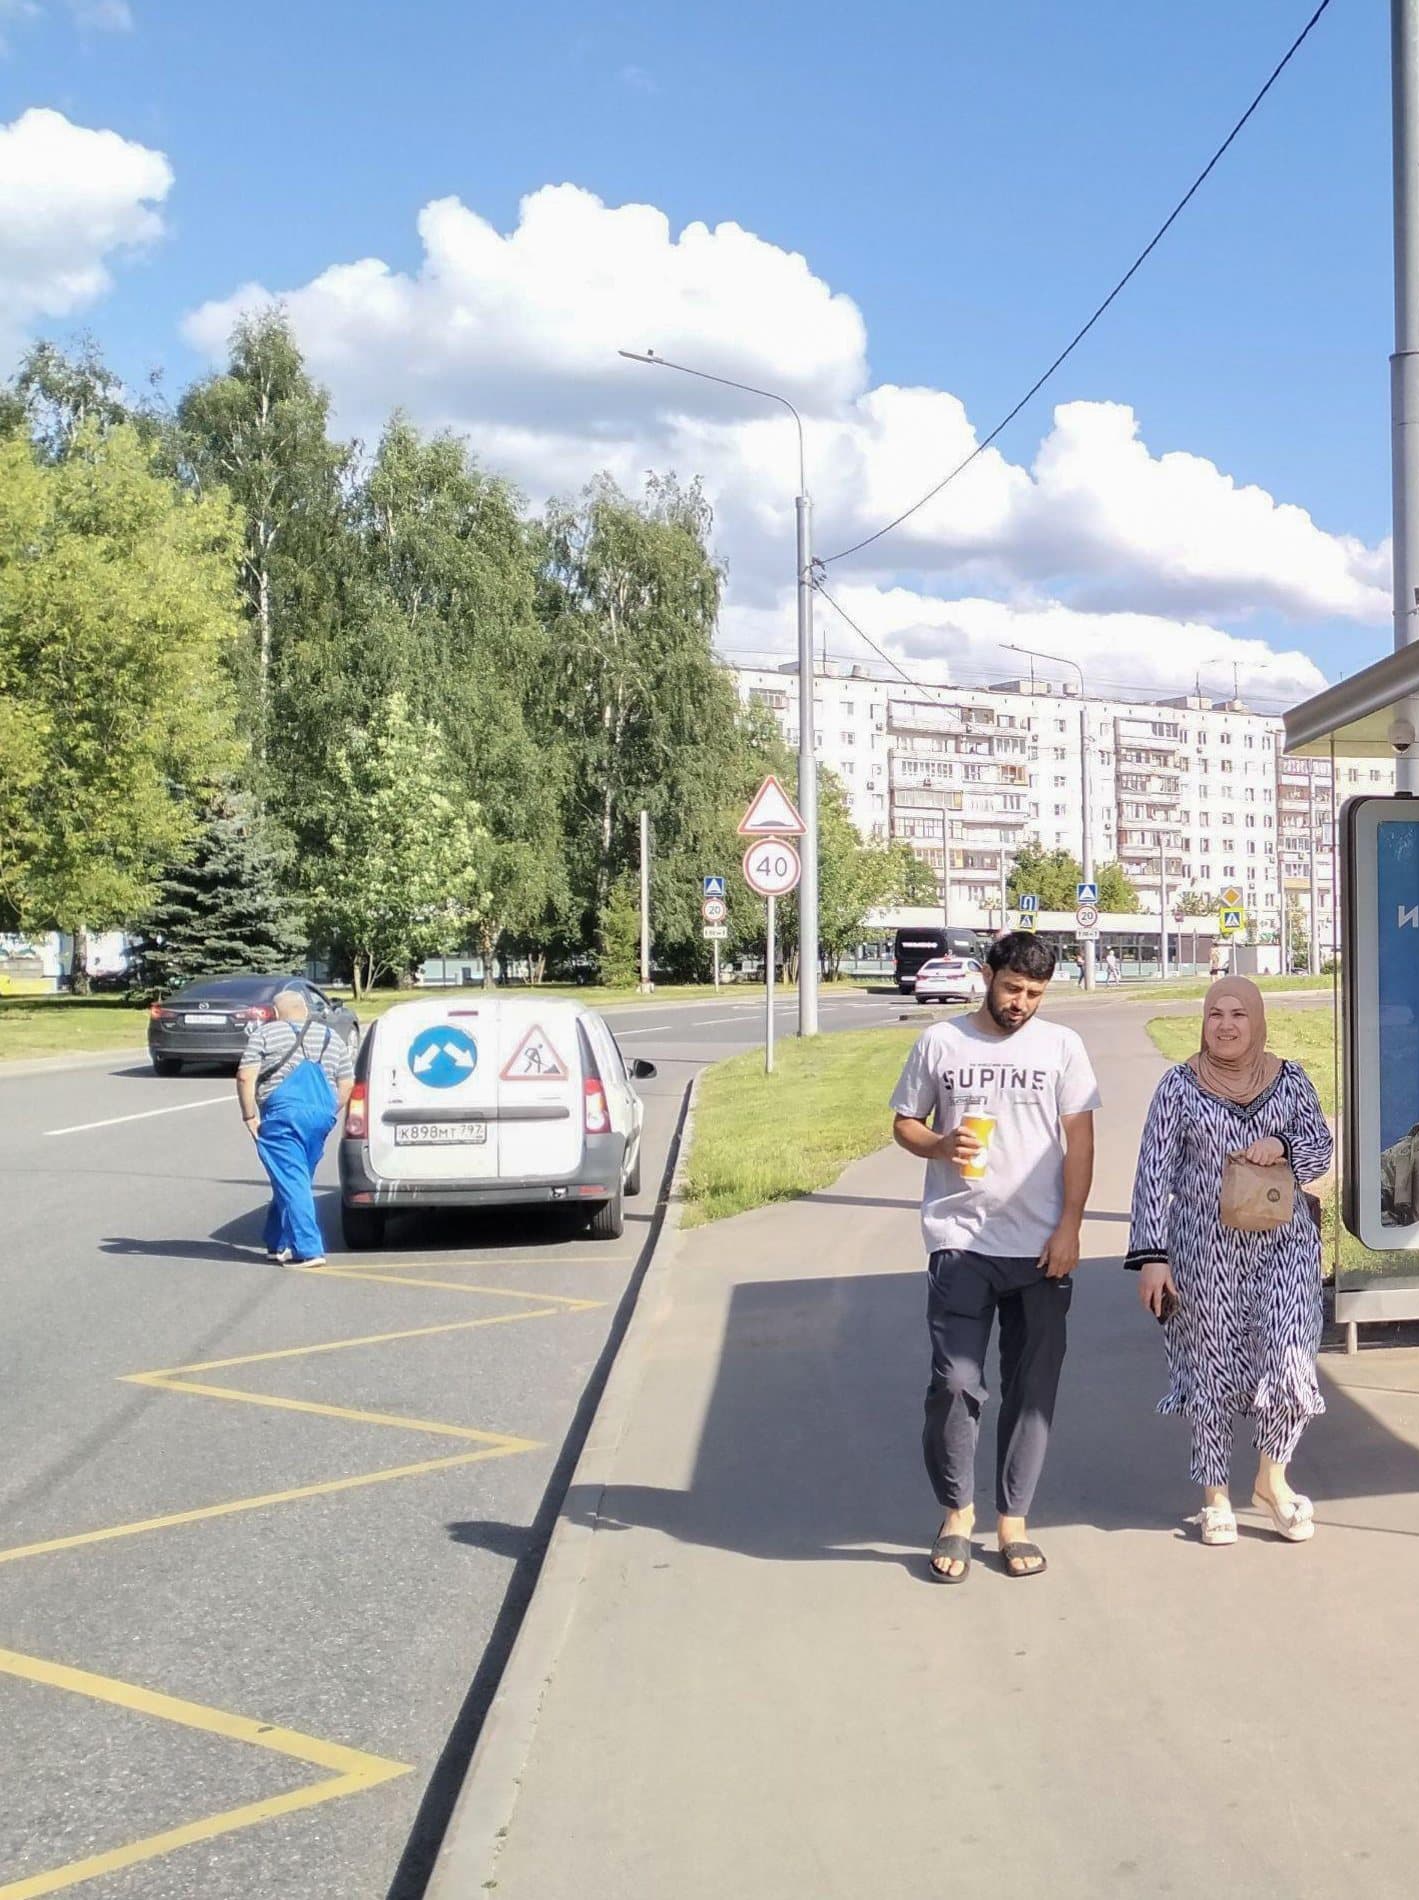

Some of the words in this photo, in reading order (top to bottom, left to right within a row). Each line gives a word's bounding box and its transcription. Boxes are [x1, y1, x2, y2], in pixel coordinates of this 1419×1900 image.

[756, 856, 788, 877] 40
[708, 905, 721, 915] 20
[1081, 911, 1094, 921] 20
[1397, 904, 1419, 929] И
[943, 1068, 1047, 1090] SUPINE
